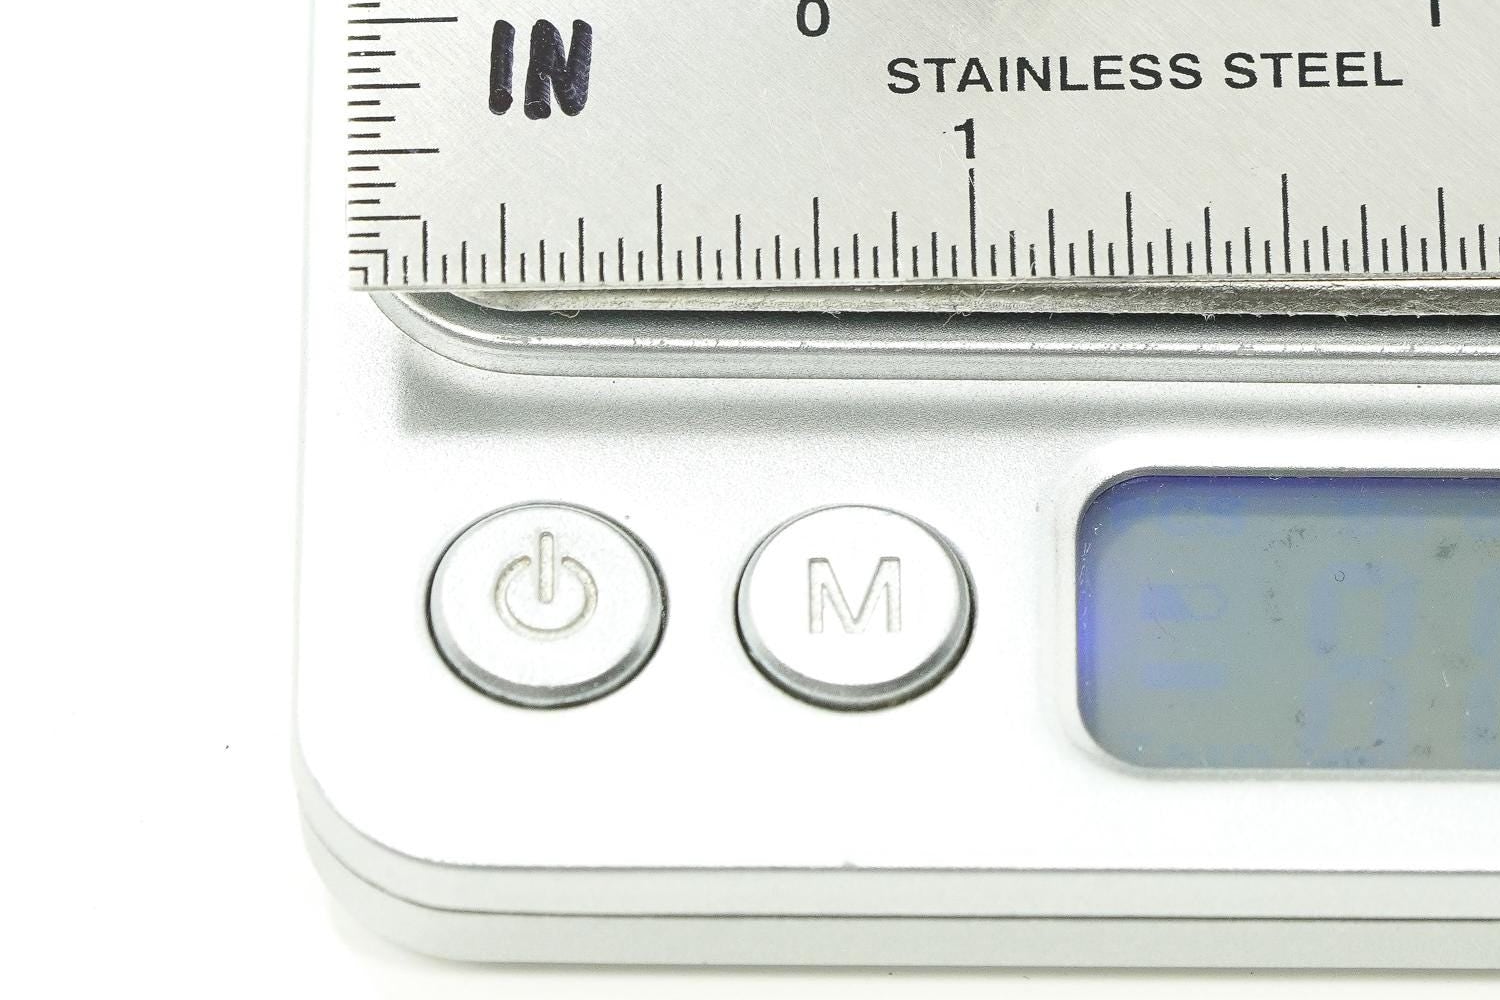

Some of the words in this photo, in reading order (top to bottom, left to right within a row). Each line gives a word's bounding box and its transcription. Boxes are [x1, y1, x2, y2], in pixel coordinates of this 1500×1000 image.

[488, 19, 593, 121] IN
[887, 52, 1203, 95] STAINLESS
[1224, 51, 1404, 90] STEEL
[953, 118, 976, 160] 1
[807, 556, 903, 634] M
